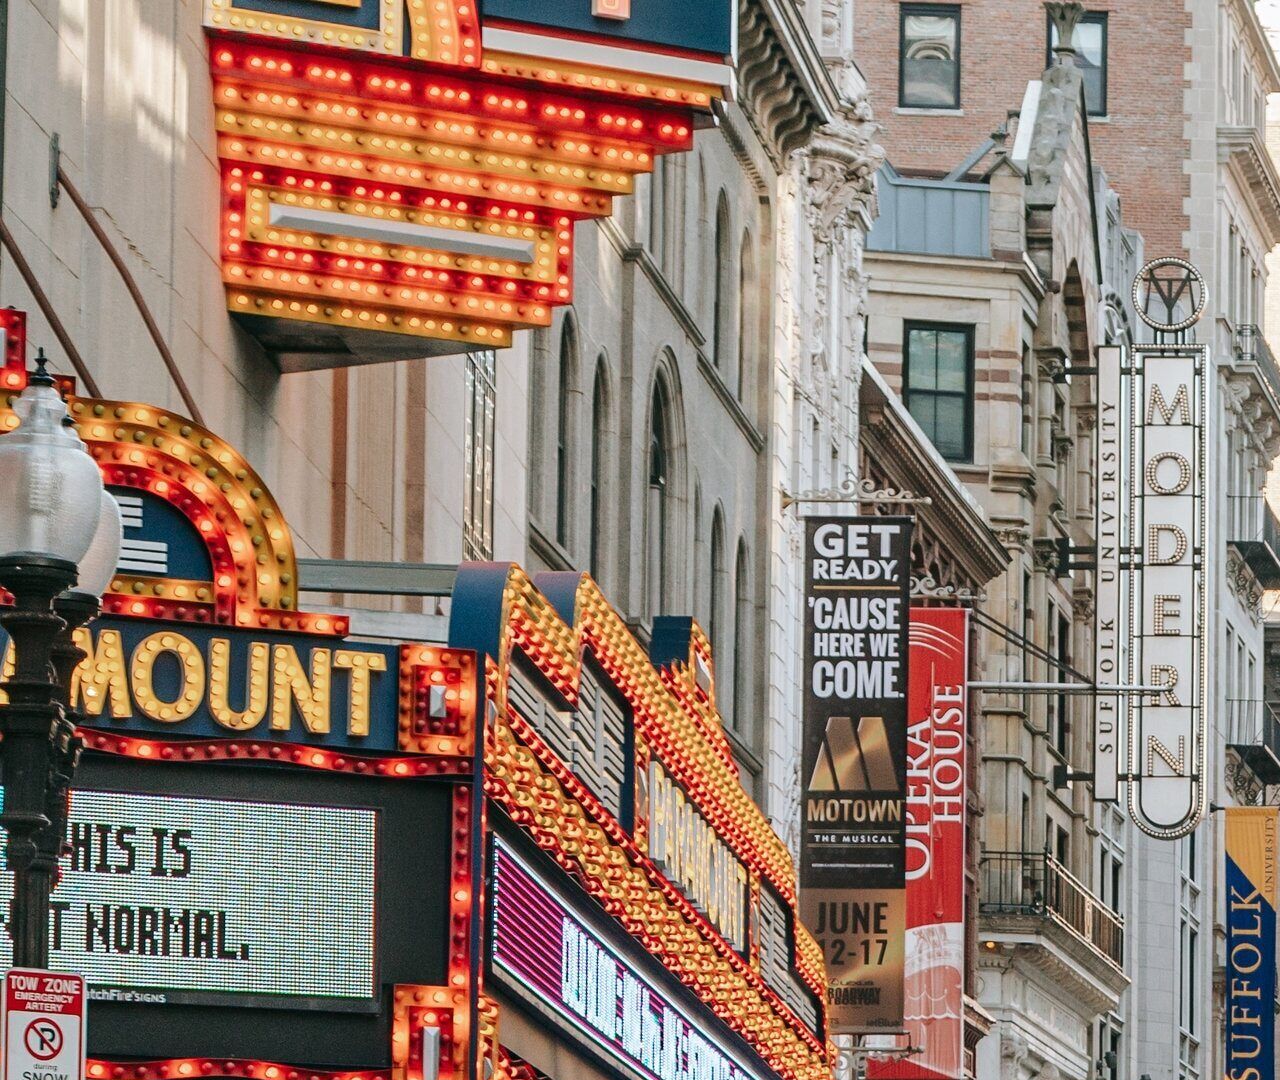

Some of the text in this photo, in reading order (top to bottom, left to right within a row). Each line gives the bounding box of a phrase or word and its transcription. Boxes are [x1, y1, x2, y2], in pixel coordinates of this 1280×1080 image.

[1101, 401, 1116, 583] UNIVERSITY
[814, 523, 900, 558] GET
[813, 559, 899, 582] READY,
[1146, 383, 1191, 777] MODERN
[808, 597, 901, 630] 'CAUSE
[814, 633, 899, 657] HERE WE
[812, 660, 905, 699] COME.
[933, 685, 964, 824] HOUSE
[807, 799, 901, 822] MOTOWN
[70, 823, 191, 877] HIS IS
[814, 834, 894, 844] THE MUSICAL
[1265, 816, 1273, 893] UNIVERSITY
[86, 902, 249, 960] NORMAL.
[815, 901, 888, 934] JUNE
[10, 975, 80, 994] TOW ZONE
[15, 992, 74, 1004] EMERGENCY
[25, 1001, 63, 1013] ARTERY
[34, 1063, 57, 1072] during
